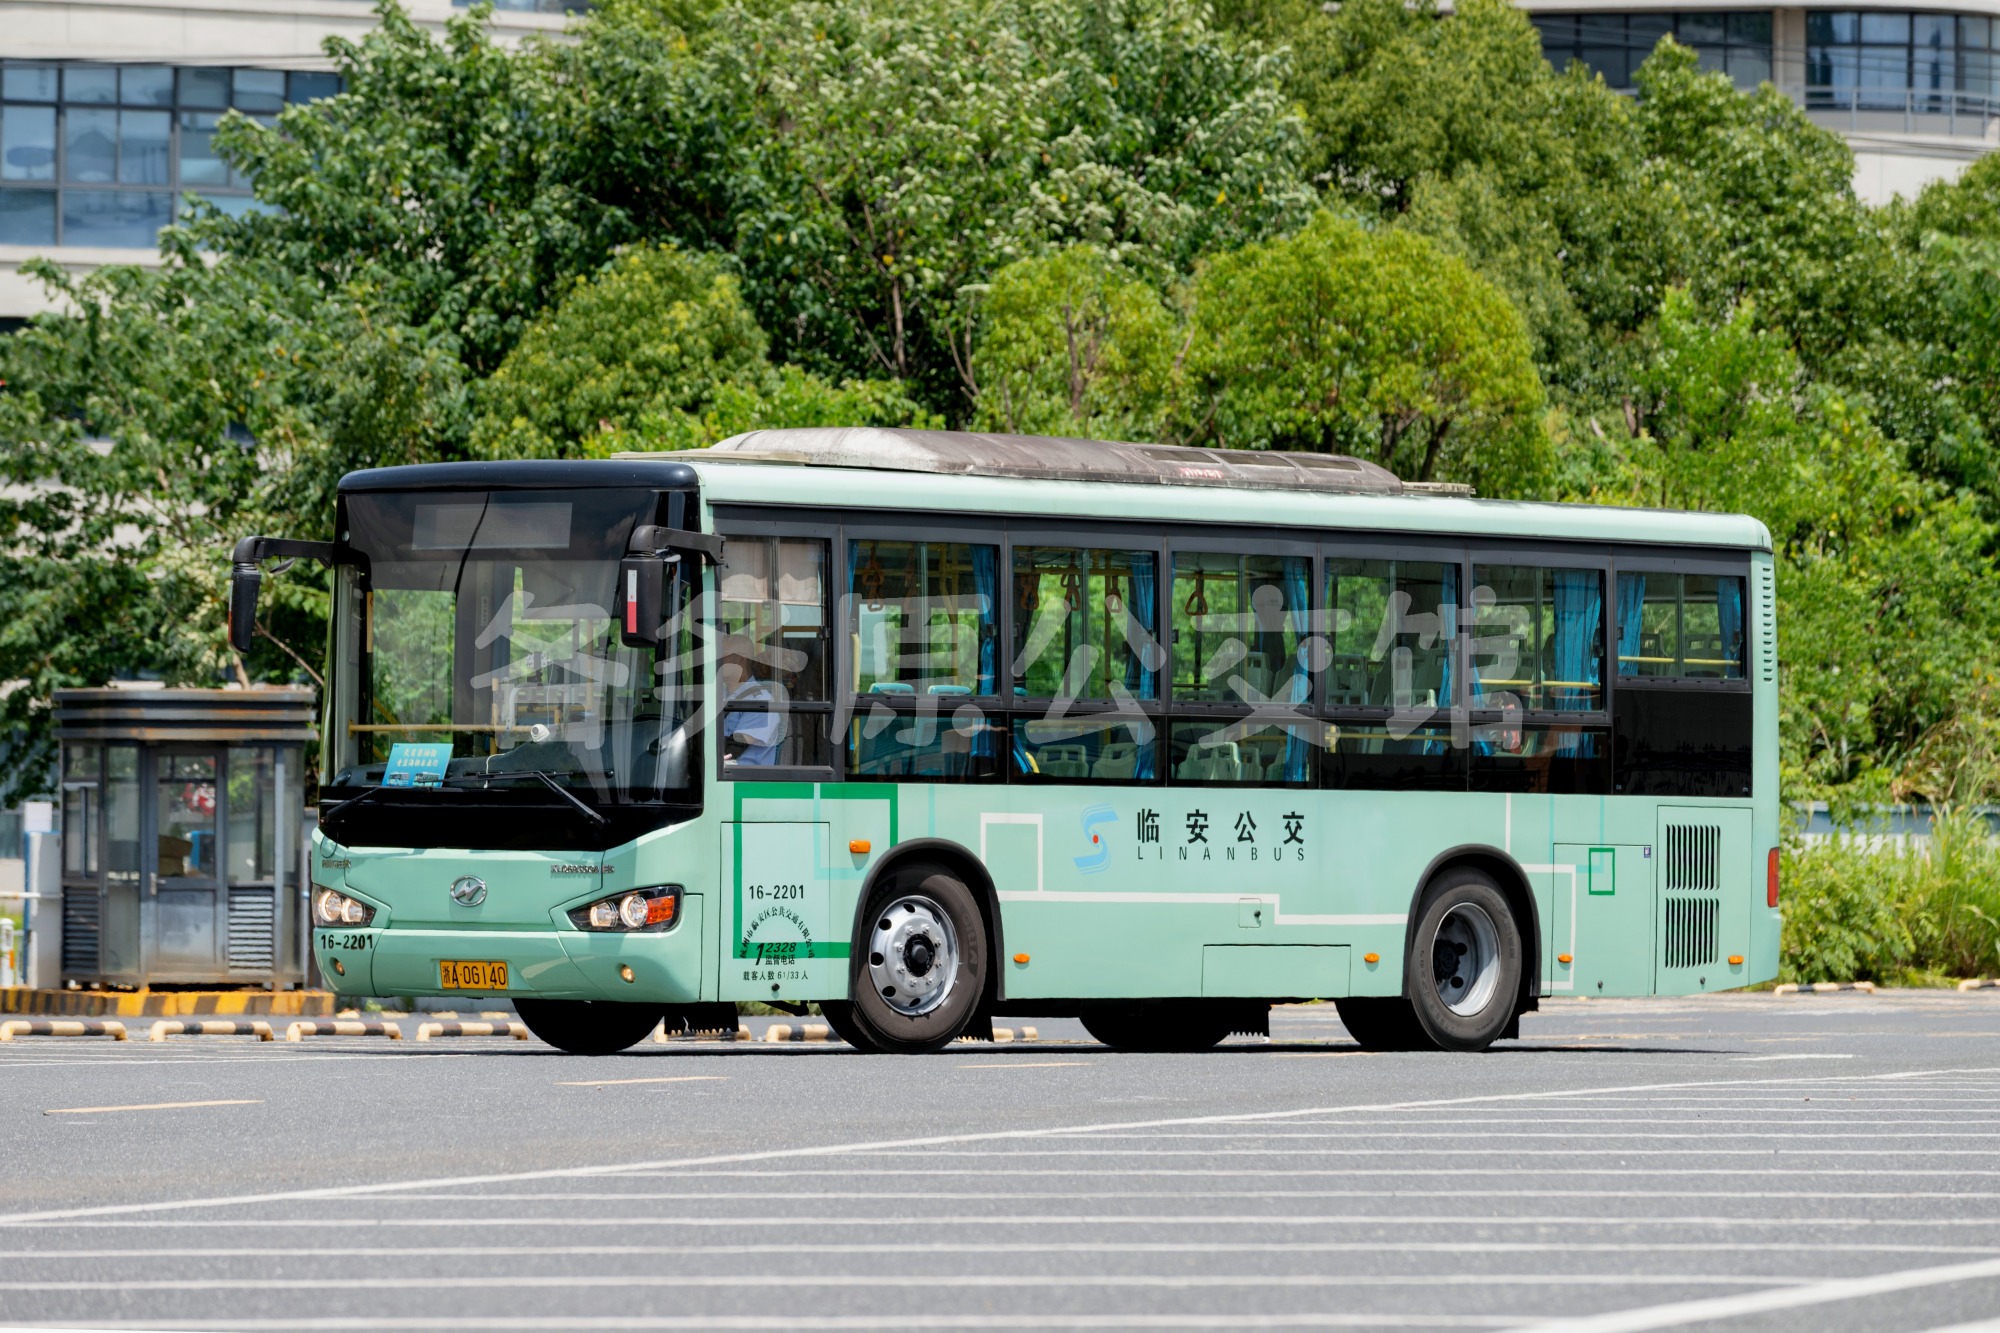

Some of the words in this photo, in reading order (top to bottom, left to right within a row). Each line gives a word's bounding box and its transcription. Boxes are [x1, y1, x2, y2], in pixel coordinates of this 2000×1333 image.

[1137, 808, 1304, 844] 临安公交
[1137, 846, 1304, 861] LINANBUS
[749, 884, 804, 899] 16-2201
[321, 934, 373, 949] 16-2201
[765, 954, 796, 965] 监督电话
